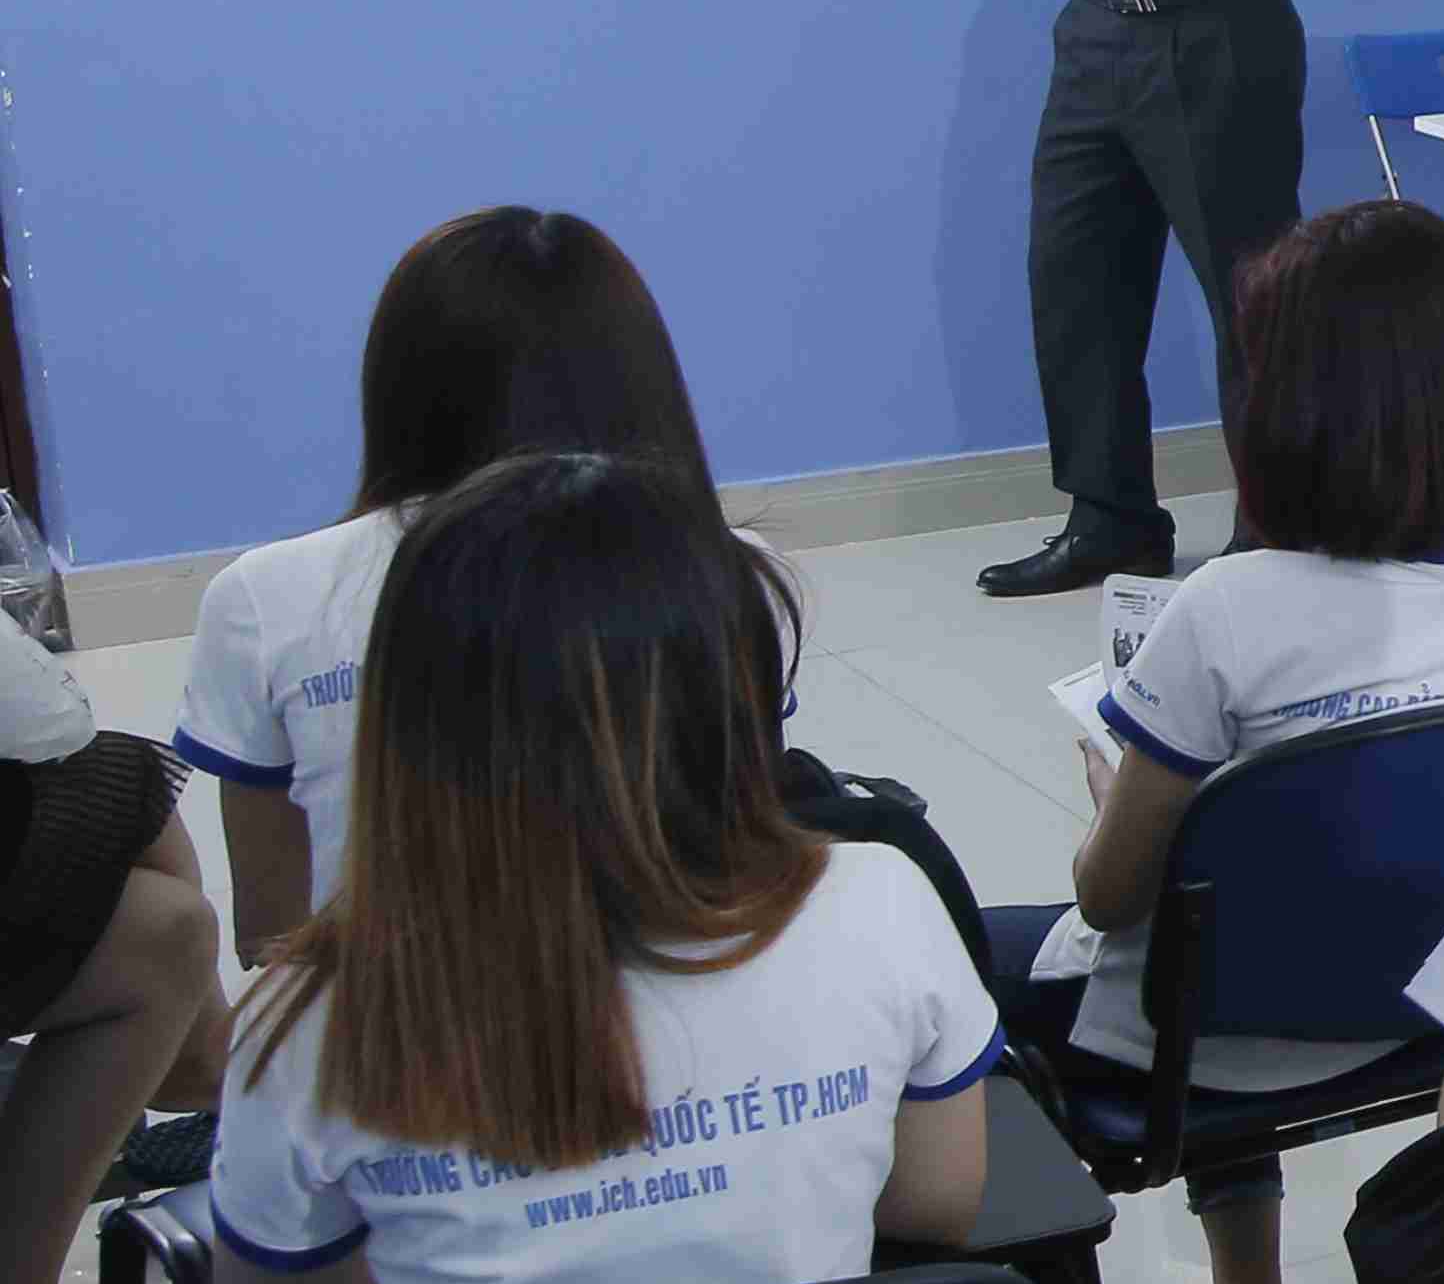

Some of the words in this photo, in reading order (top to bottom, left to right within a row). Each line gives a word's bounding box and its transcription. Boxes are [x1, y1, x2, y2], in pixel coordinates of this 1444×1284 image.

[722, 1075, 764, 1135] TẾ
[772, 1063, 870, 1127] TP.HCM
[523, 1162, 729, 1229] www.ich.edu.vn
